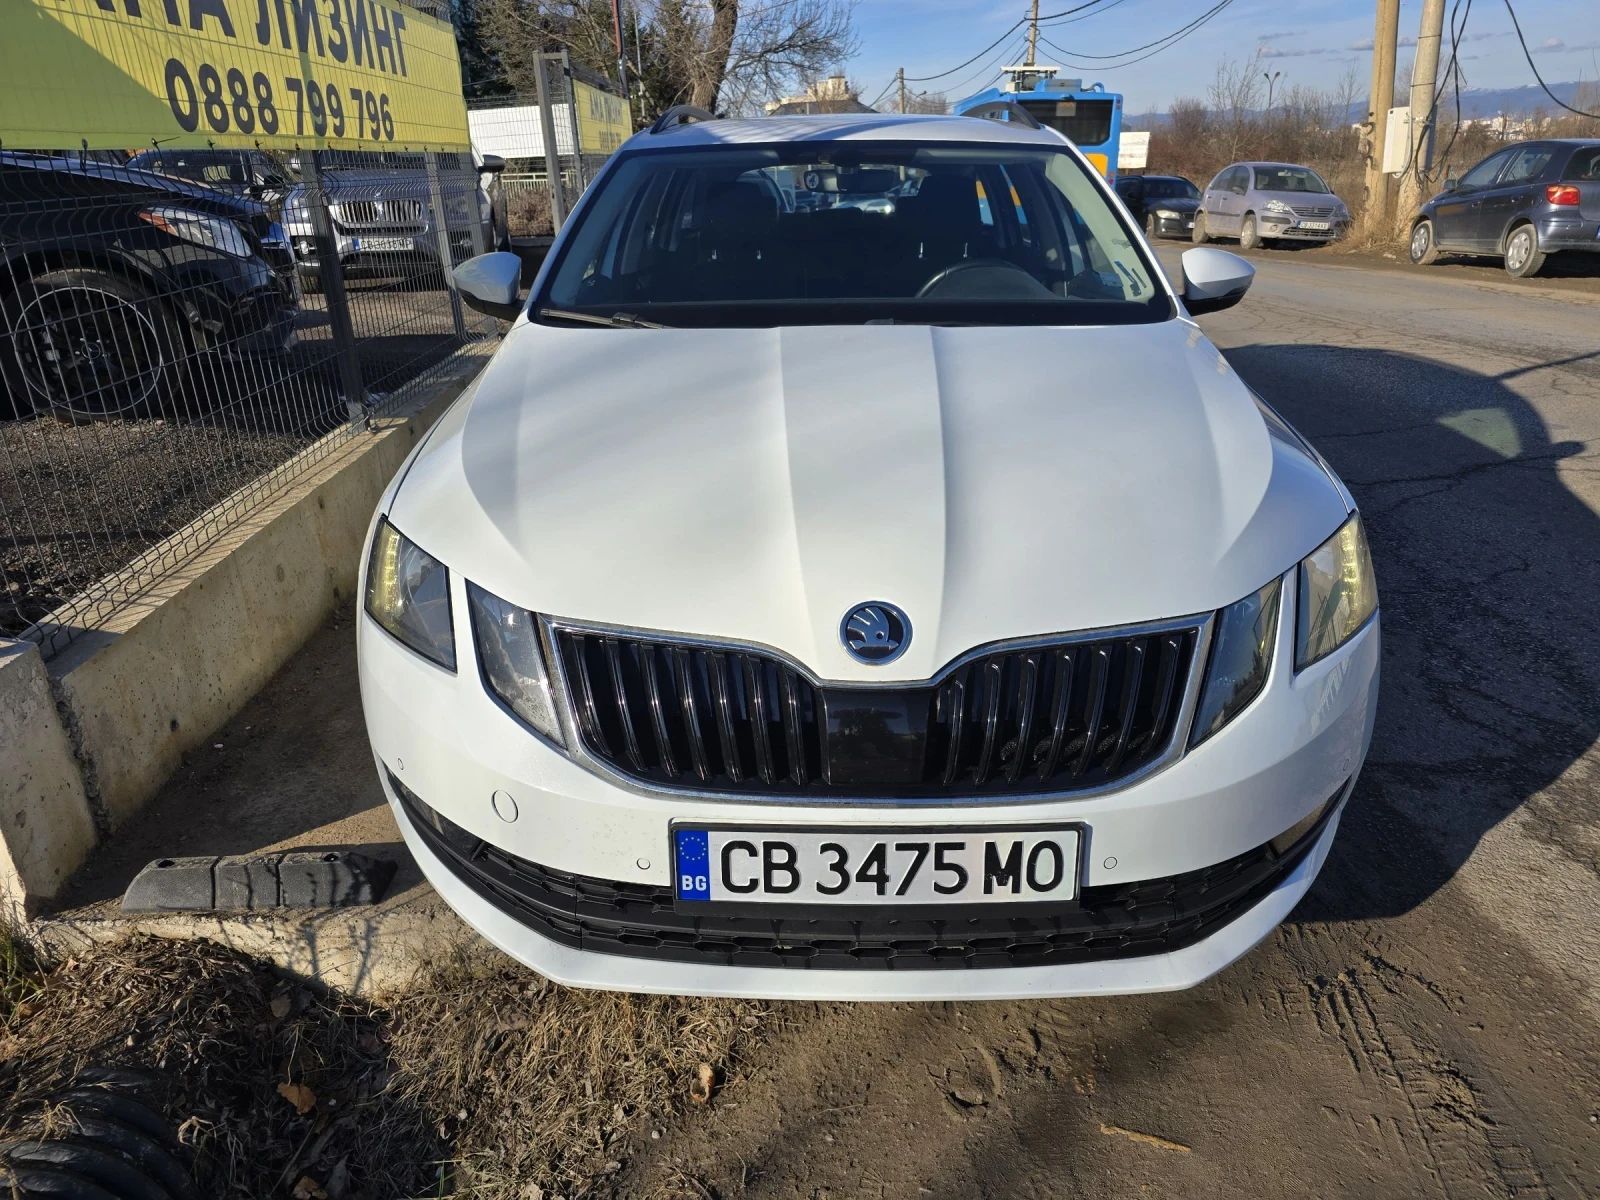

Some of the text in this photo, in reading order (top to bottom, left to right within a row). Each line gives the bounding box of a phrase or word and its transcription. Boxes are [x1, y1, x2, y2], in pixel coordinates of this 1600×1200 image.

[165, 58, 395, 142] 0888 799 796
[682, 874, 708, 891] BG
[720, 840, 1064, 896] CB 3475 MO
